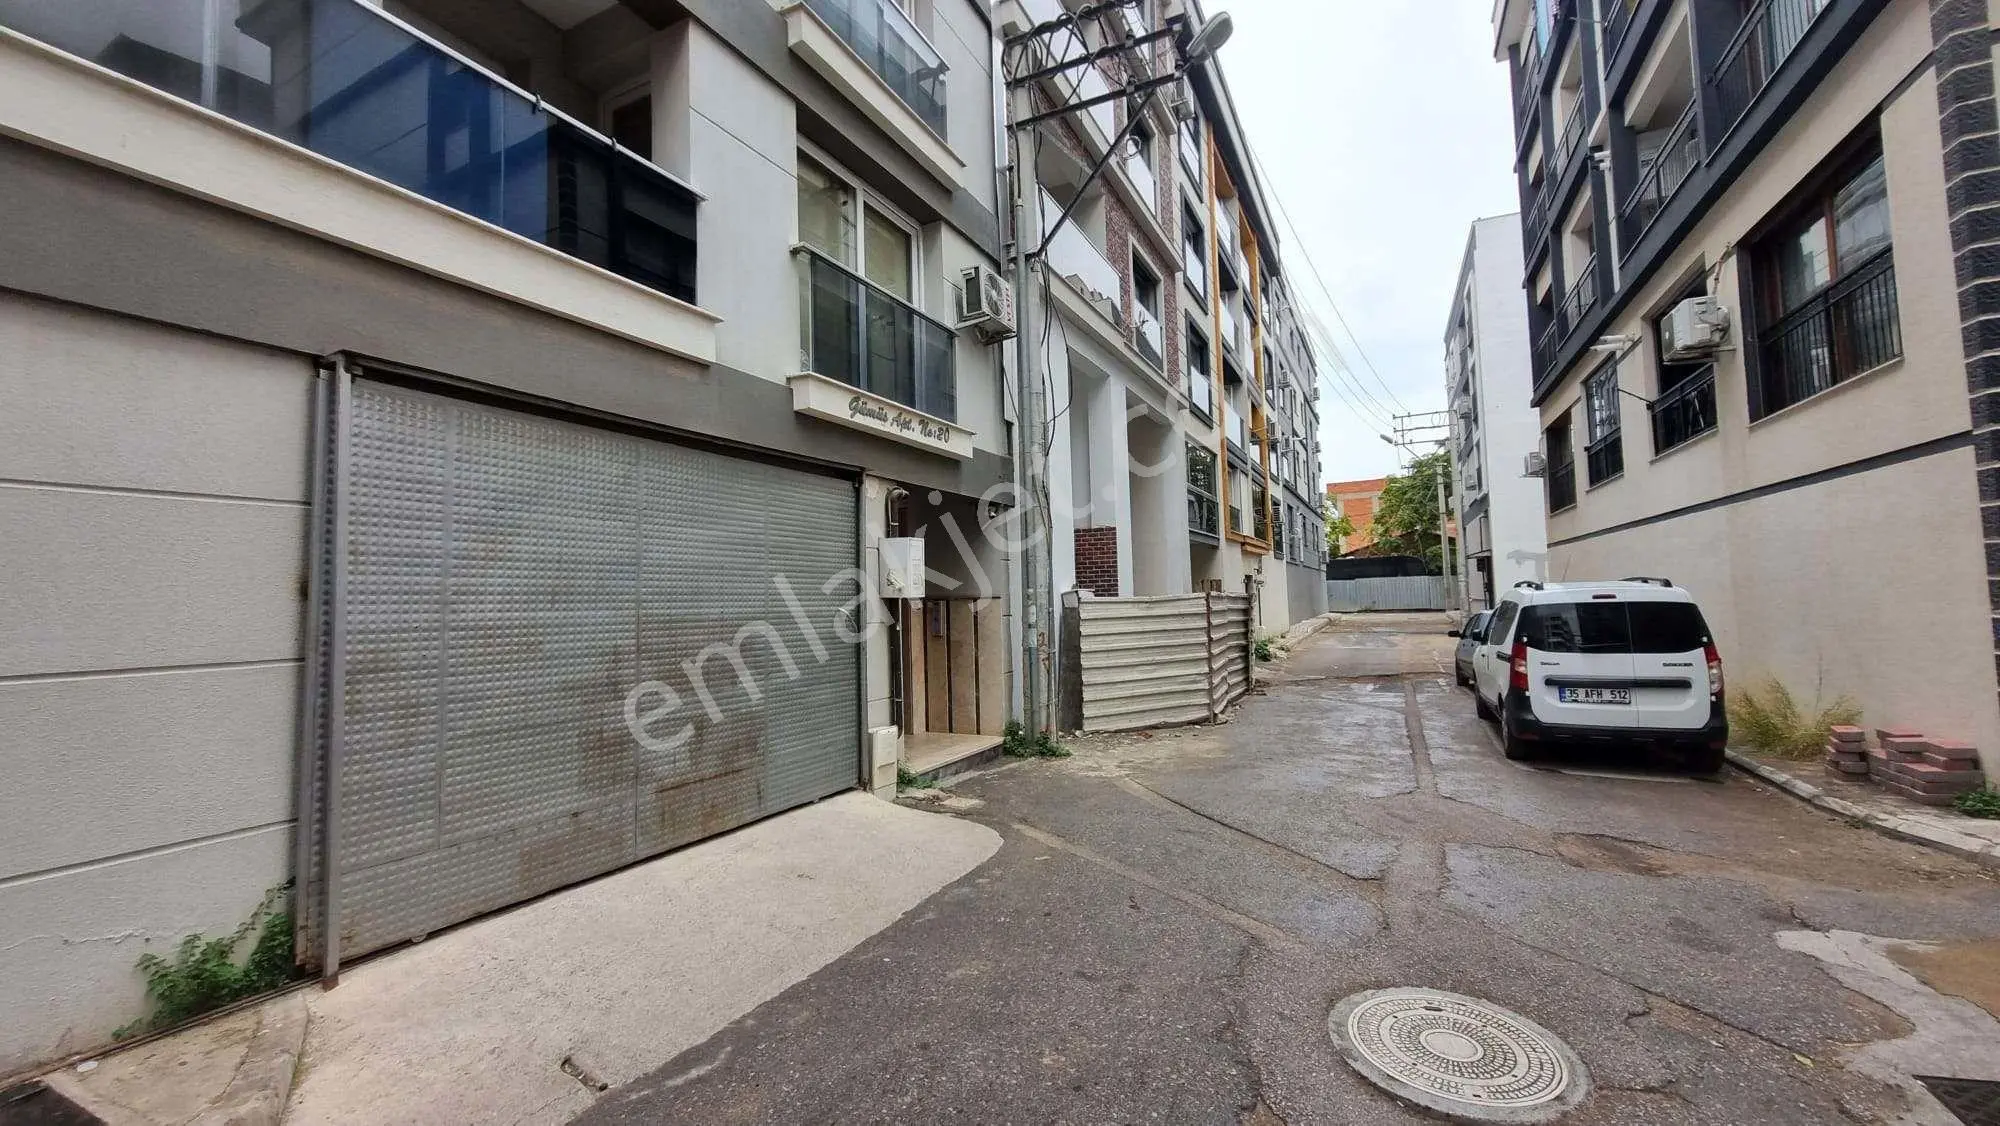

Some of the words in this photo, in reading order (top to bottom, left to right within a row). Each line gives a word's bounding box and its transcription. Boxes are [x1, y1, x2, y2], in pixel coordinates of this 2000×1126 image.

[890, 411, 915, 433] Apt.
[918, 418, 950, 444] No:20
[1566, 688, 1579, 698] 35
[1584, 688, 1603, 699] AFH
[1610, 689, 1628, 700] 512
